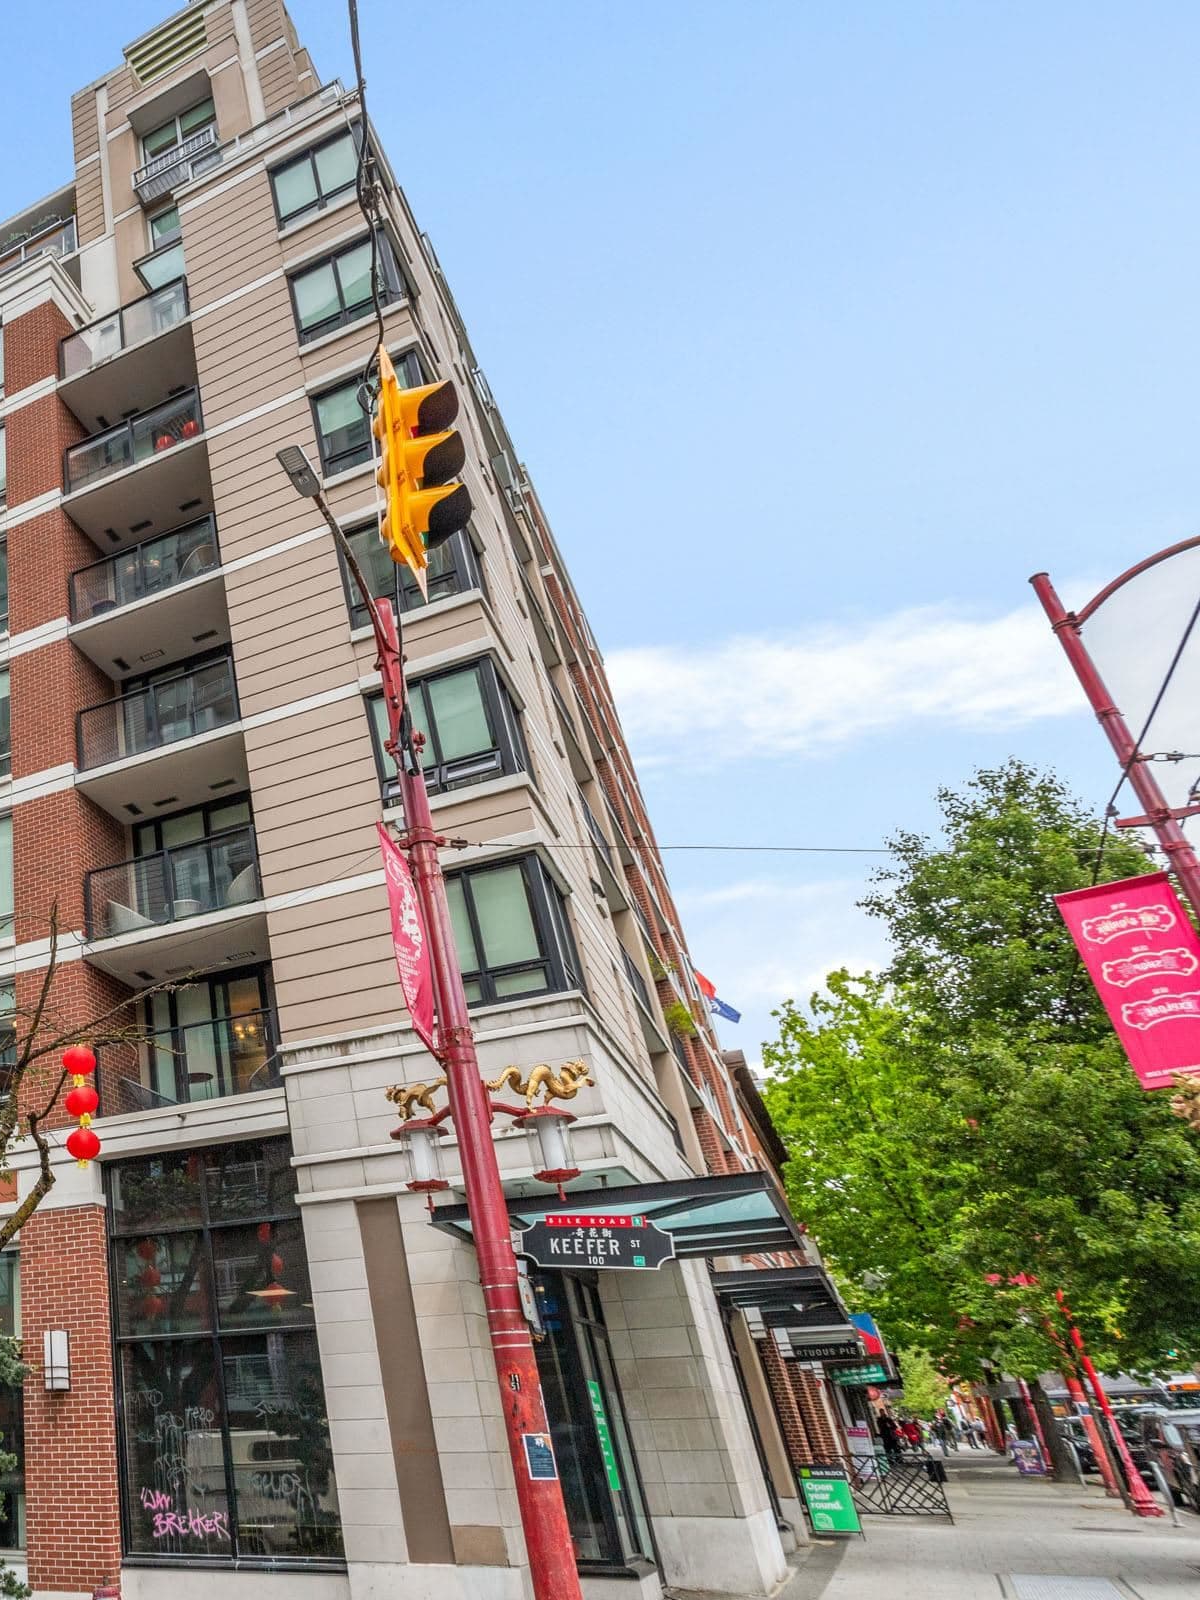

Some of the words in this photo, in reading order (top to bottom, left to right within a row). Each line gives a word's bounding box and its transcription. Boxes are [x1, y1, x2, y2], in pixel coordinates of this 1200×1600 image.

[548, 1217, 581, 1225] SILK
[590, 1217, 626, 1225] ROAD
[550, 1238, 620, 1255] KEEFER
[630, 1240, 641, 1248] ST
[588, 1256, 604, 1265] 100
[839, 1347, 857, 1355] PIE
[806, 1482, 833, 1492] Open
[808, 1493, 830, 1501] year
[810, 1501, 843, 1511] round.
